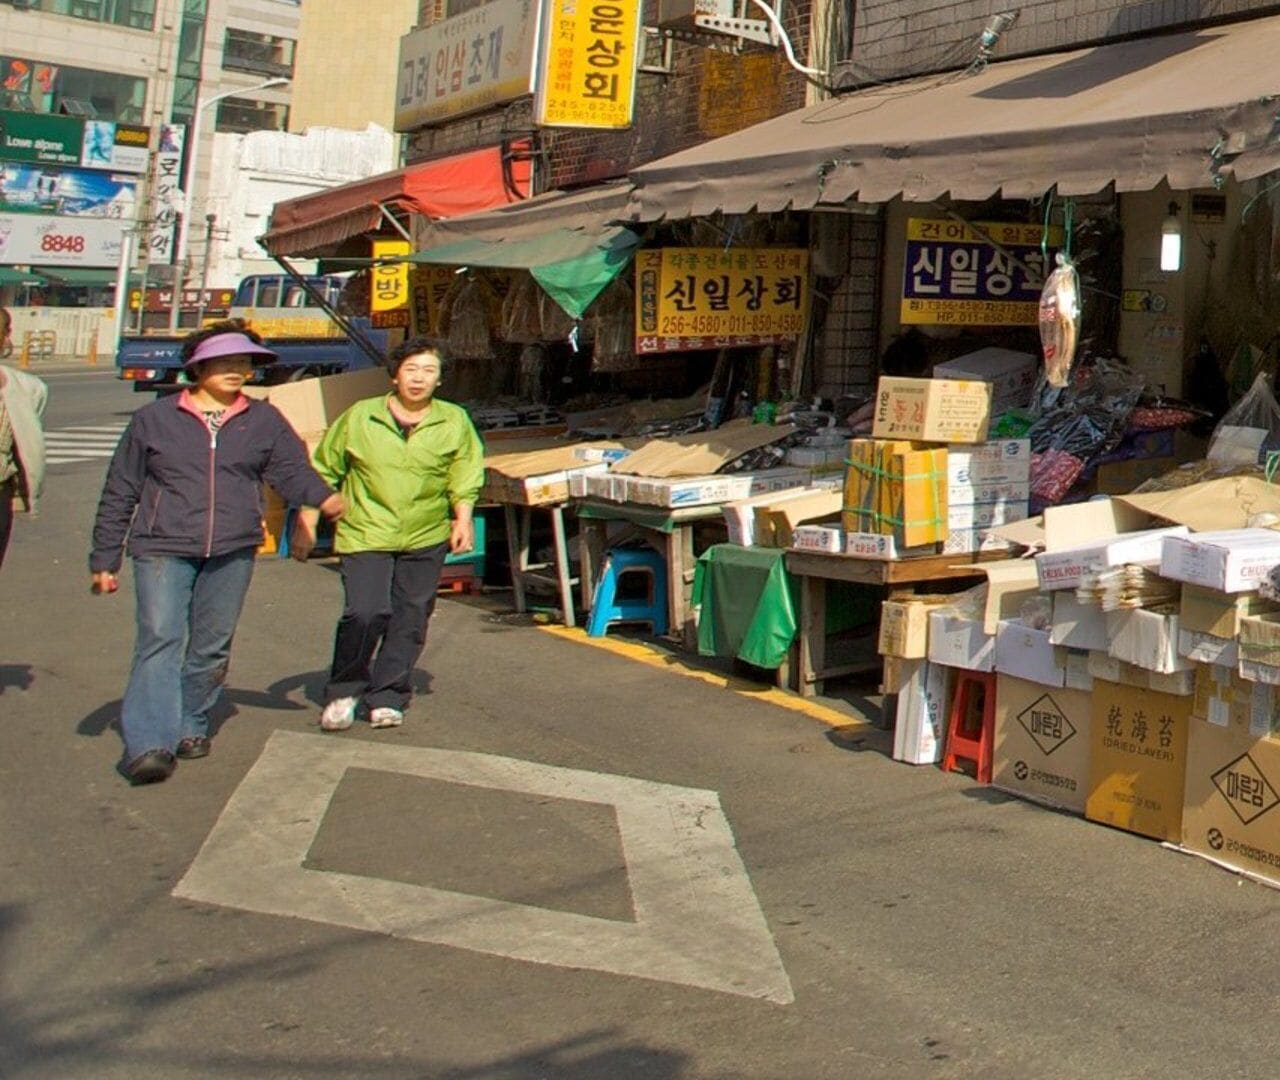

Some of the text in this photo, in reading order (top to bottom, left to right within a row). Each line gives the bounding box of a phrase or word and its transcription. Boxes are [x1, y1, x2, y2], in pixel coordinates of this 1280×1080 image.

[400, 52, 432, 106] 고려
[435, 39, 466, 98] 인삼
[6, 134, 65, 151] Lowe alpine
[41, 234, 85, 253] 8848
[919, 222, 990, 241] 건어물
[664, 274, 803, 313] 신일상회
[661, 315, 721, 335] 256-4580
[1030, 709, 1063, 740] 마른김
[1107, 704, 1176, 748] 乾海苔
[1103, 736, 1137, 754] (DRIED
[1226, 770, 1265, 809] 마른김
